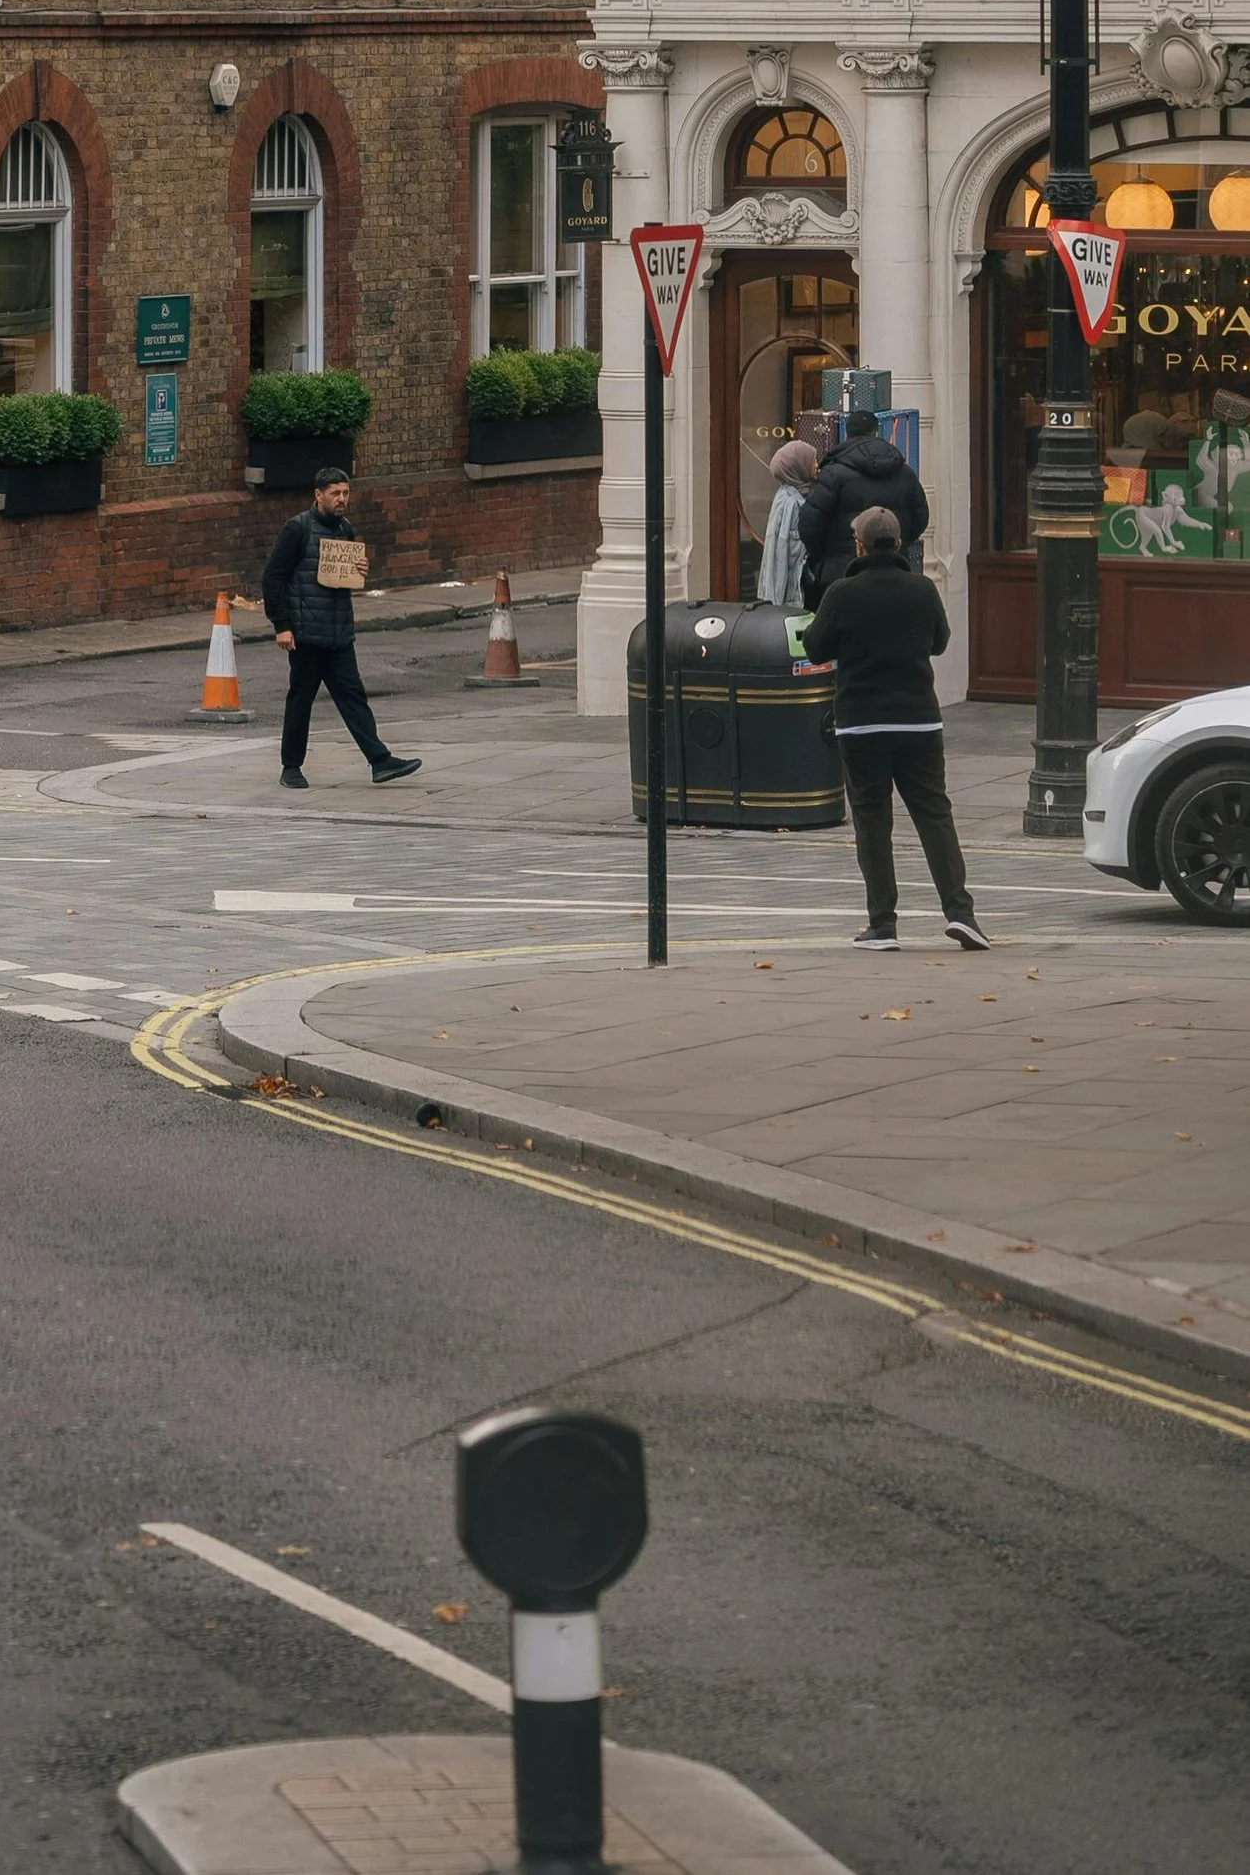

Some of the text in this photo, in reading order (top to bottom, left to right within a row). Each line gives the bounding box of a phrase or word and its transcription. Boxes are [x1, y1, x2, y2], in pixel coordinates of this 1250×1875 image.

[222, 75, 239, 85] C&G
[579, 120, 596, 136] 116
[568, 216, 608, 227] GOYARD
[1071, 237, 1112, 266] GIVE
[647, 246, 686, 277] GIVE
[1083, 268, 1109, 288] WAY
[656, 284, 680, 304] WAY
[143, 334, 185, 345] PRIVATE MEWS
[320, 564, 337, 574] GOD
